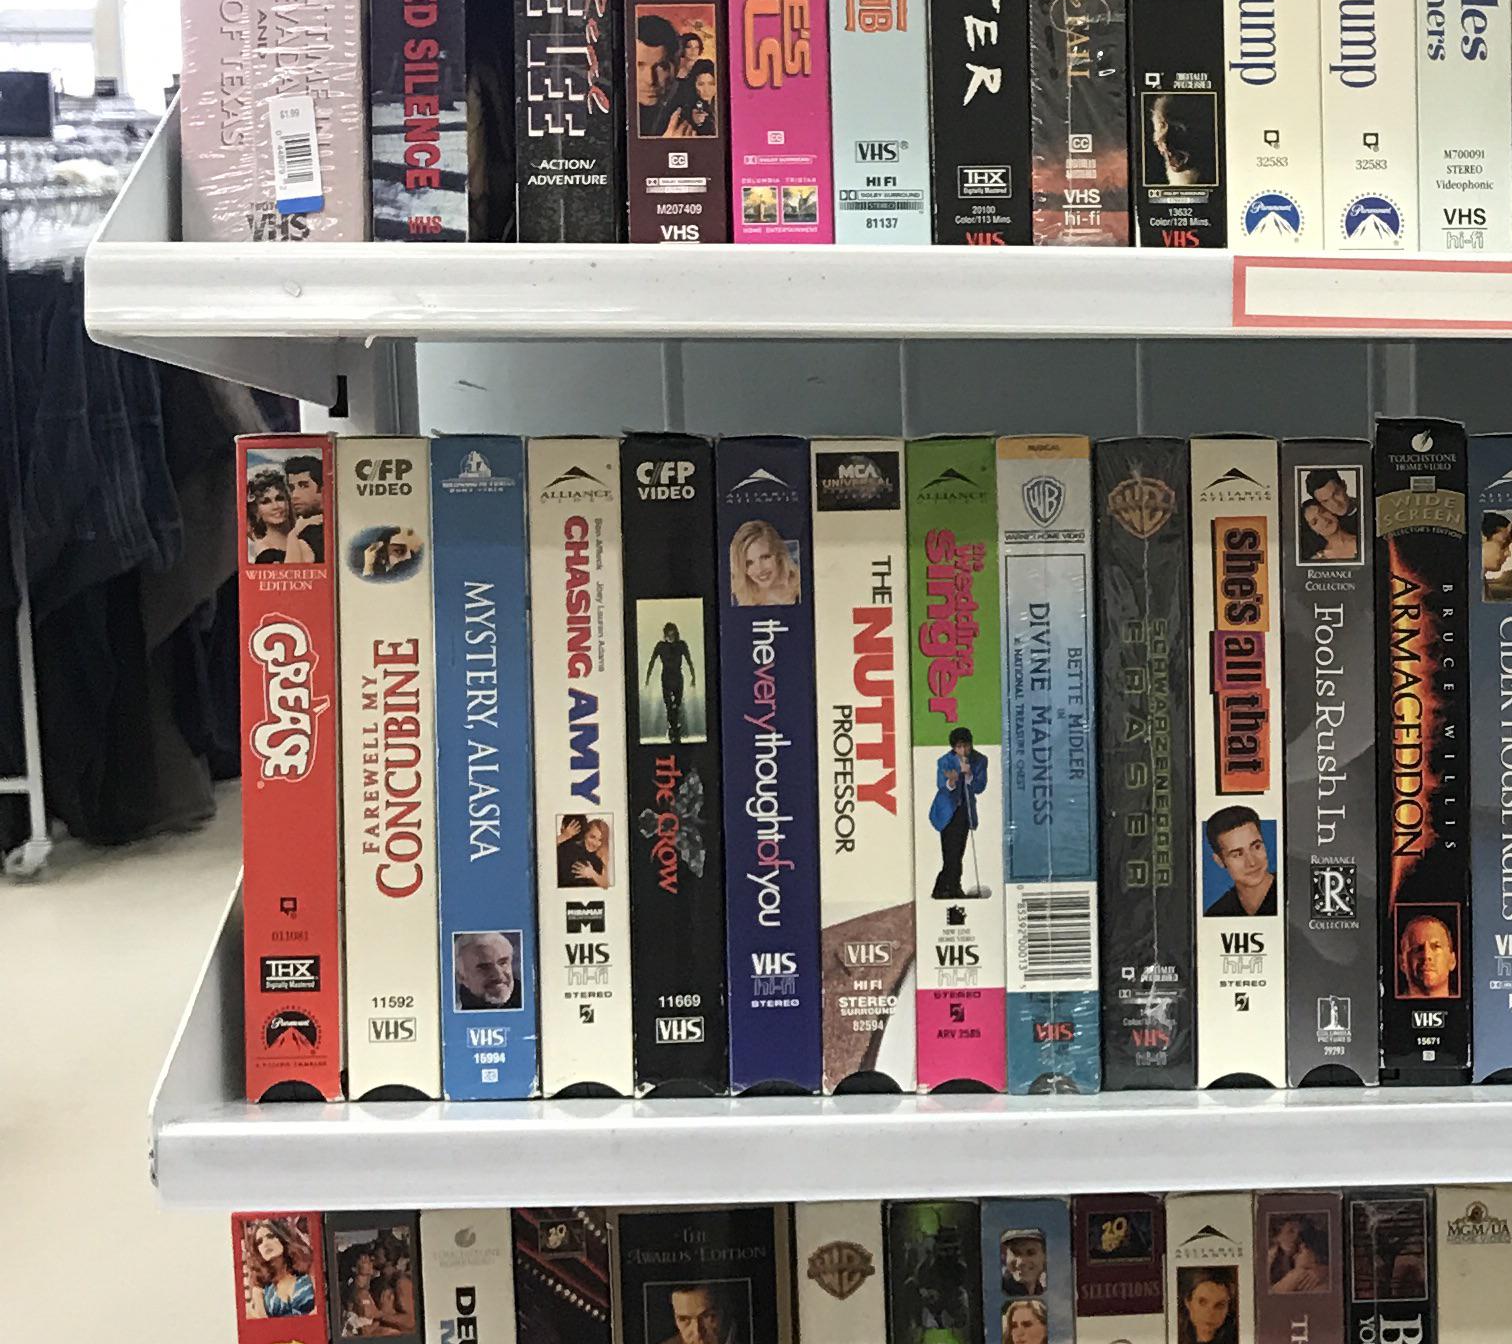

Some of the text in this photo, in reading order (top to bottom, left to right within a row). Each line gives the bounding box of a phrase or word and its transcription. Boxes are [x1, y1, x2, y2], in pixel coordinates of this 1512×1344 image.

[402, 39, 442, 189] SILENCE
[527, 173, 607, 185] ADVENTURE
[1256, 156, 1288, 167] 32583
[464, 582, 500, 863] MYSTERY, ALASKA
[563, 516, 598, 805] CHASING AMY
[851, 606, 898, 816] NUTTY
[1314, 602, 1346, 845] Fools Rush In
[1390, 573, 1423, 857] ARMAGEDDON
[361, 674, 380, 854] FAREWELL MY
[376, 637, 422, 898] CONCUBINE
[832, 704, 855, 855] PROFESSOR
[371, 997, 414, 1008] 11592
[658, 1019, 702, 1040] VHS
